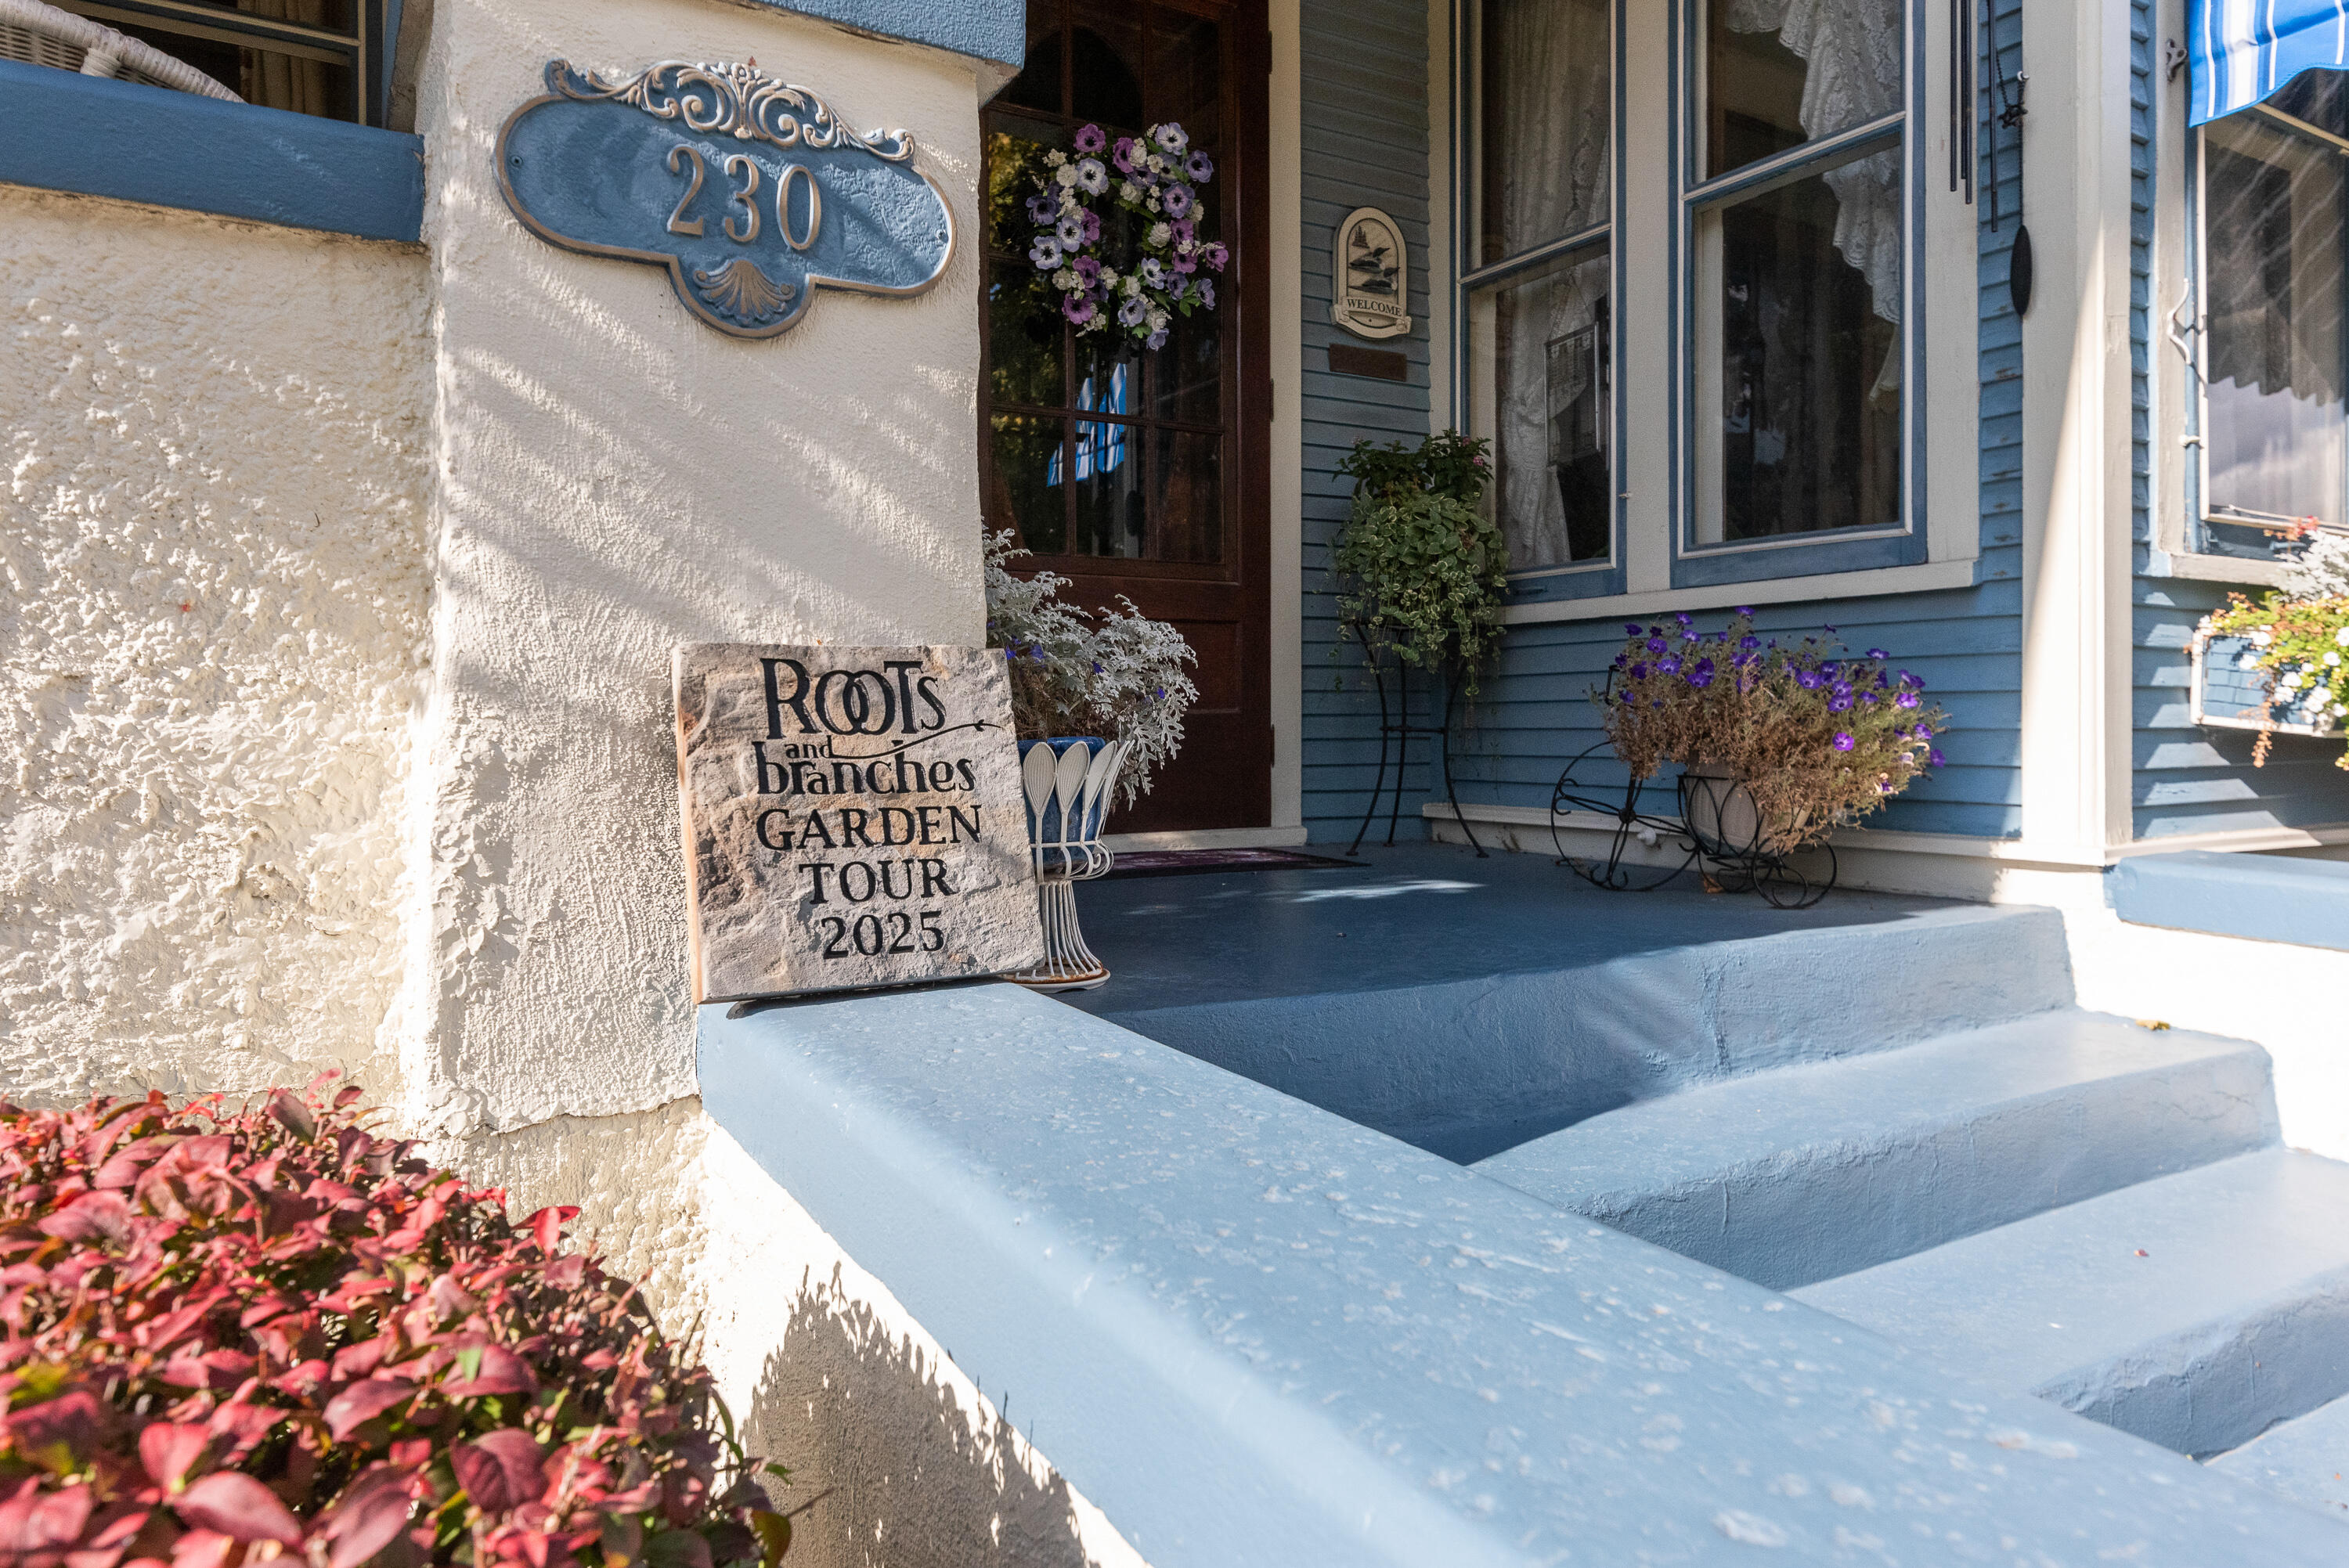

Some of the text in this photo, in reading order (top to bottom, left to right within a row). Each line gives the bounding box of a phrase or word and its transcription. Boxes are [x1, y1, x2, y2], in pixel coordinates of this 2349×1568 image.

[666, 144, 822, 251] 230
[1347, 299, 1402, 316] WELCOME
[752, 740, 976, 795] branches
[785, 734, 833, 759] and
[756, 805, 982, 851] GARDEN
[799, 858, 958, 905] TOUR
[821, 910, 945, 960] 2025
